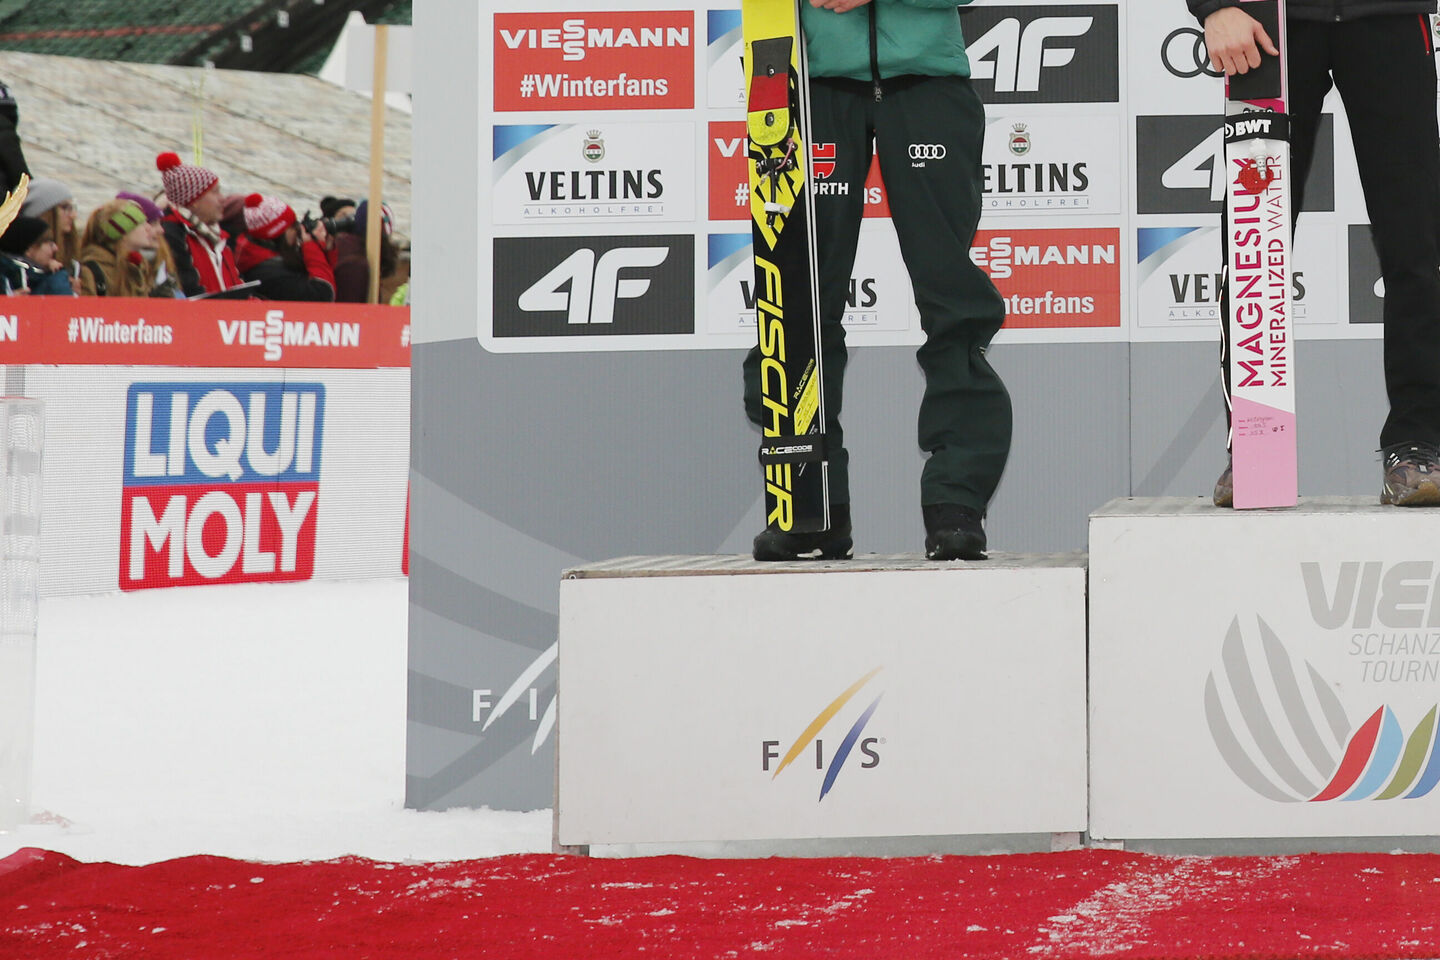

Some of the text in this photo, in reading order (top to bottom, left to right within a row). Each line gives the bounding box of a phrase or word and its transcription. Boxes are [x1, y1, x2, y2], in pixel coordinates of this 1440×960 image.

[500, 18, 690, 62] VIESSMANN
[968, 16, 1094, 93] 4F
[520, 73, 668, 99] #Winterfans
[1235, 119, 1271, 136] BWT
[525, 169, 664, 202] VELTINS
[982, 162, 1089, 194] ELTINS
[524, 205, 665, 215] ALKOHOLFREI
[991, 199, 1089, 208] OHOLFREI
[968, 237, 1115, 279] ESSMANN
[518, 247, 670, 325] 4F
[67, 316, 172, 344] #Winterfans
[1268, 239, 1287, 387] MINERALIZED
[218, 310, 361, 361] VIESSMANN
[755, 255, 793, 533] FISCHER
[132, 388, 317, 482] LIQUI
[128, 490, 317, 582] MOLY
[472, 688, 538, 723] FI
[762, 737, 881, 772] FIS
